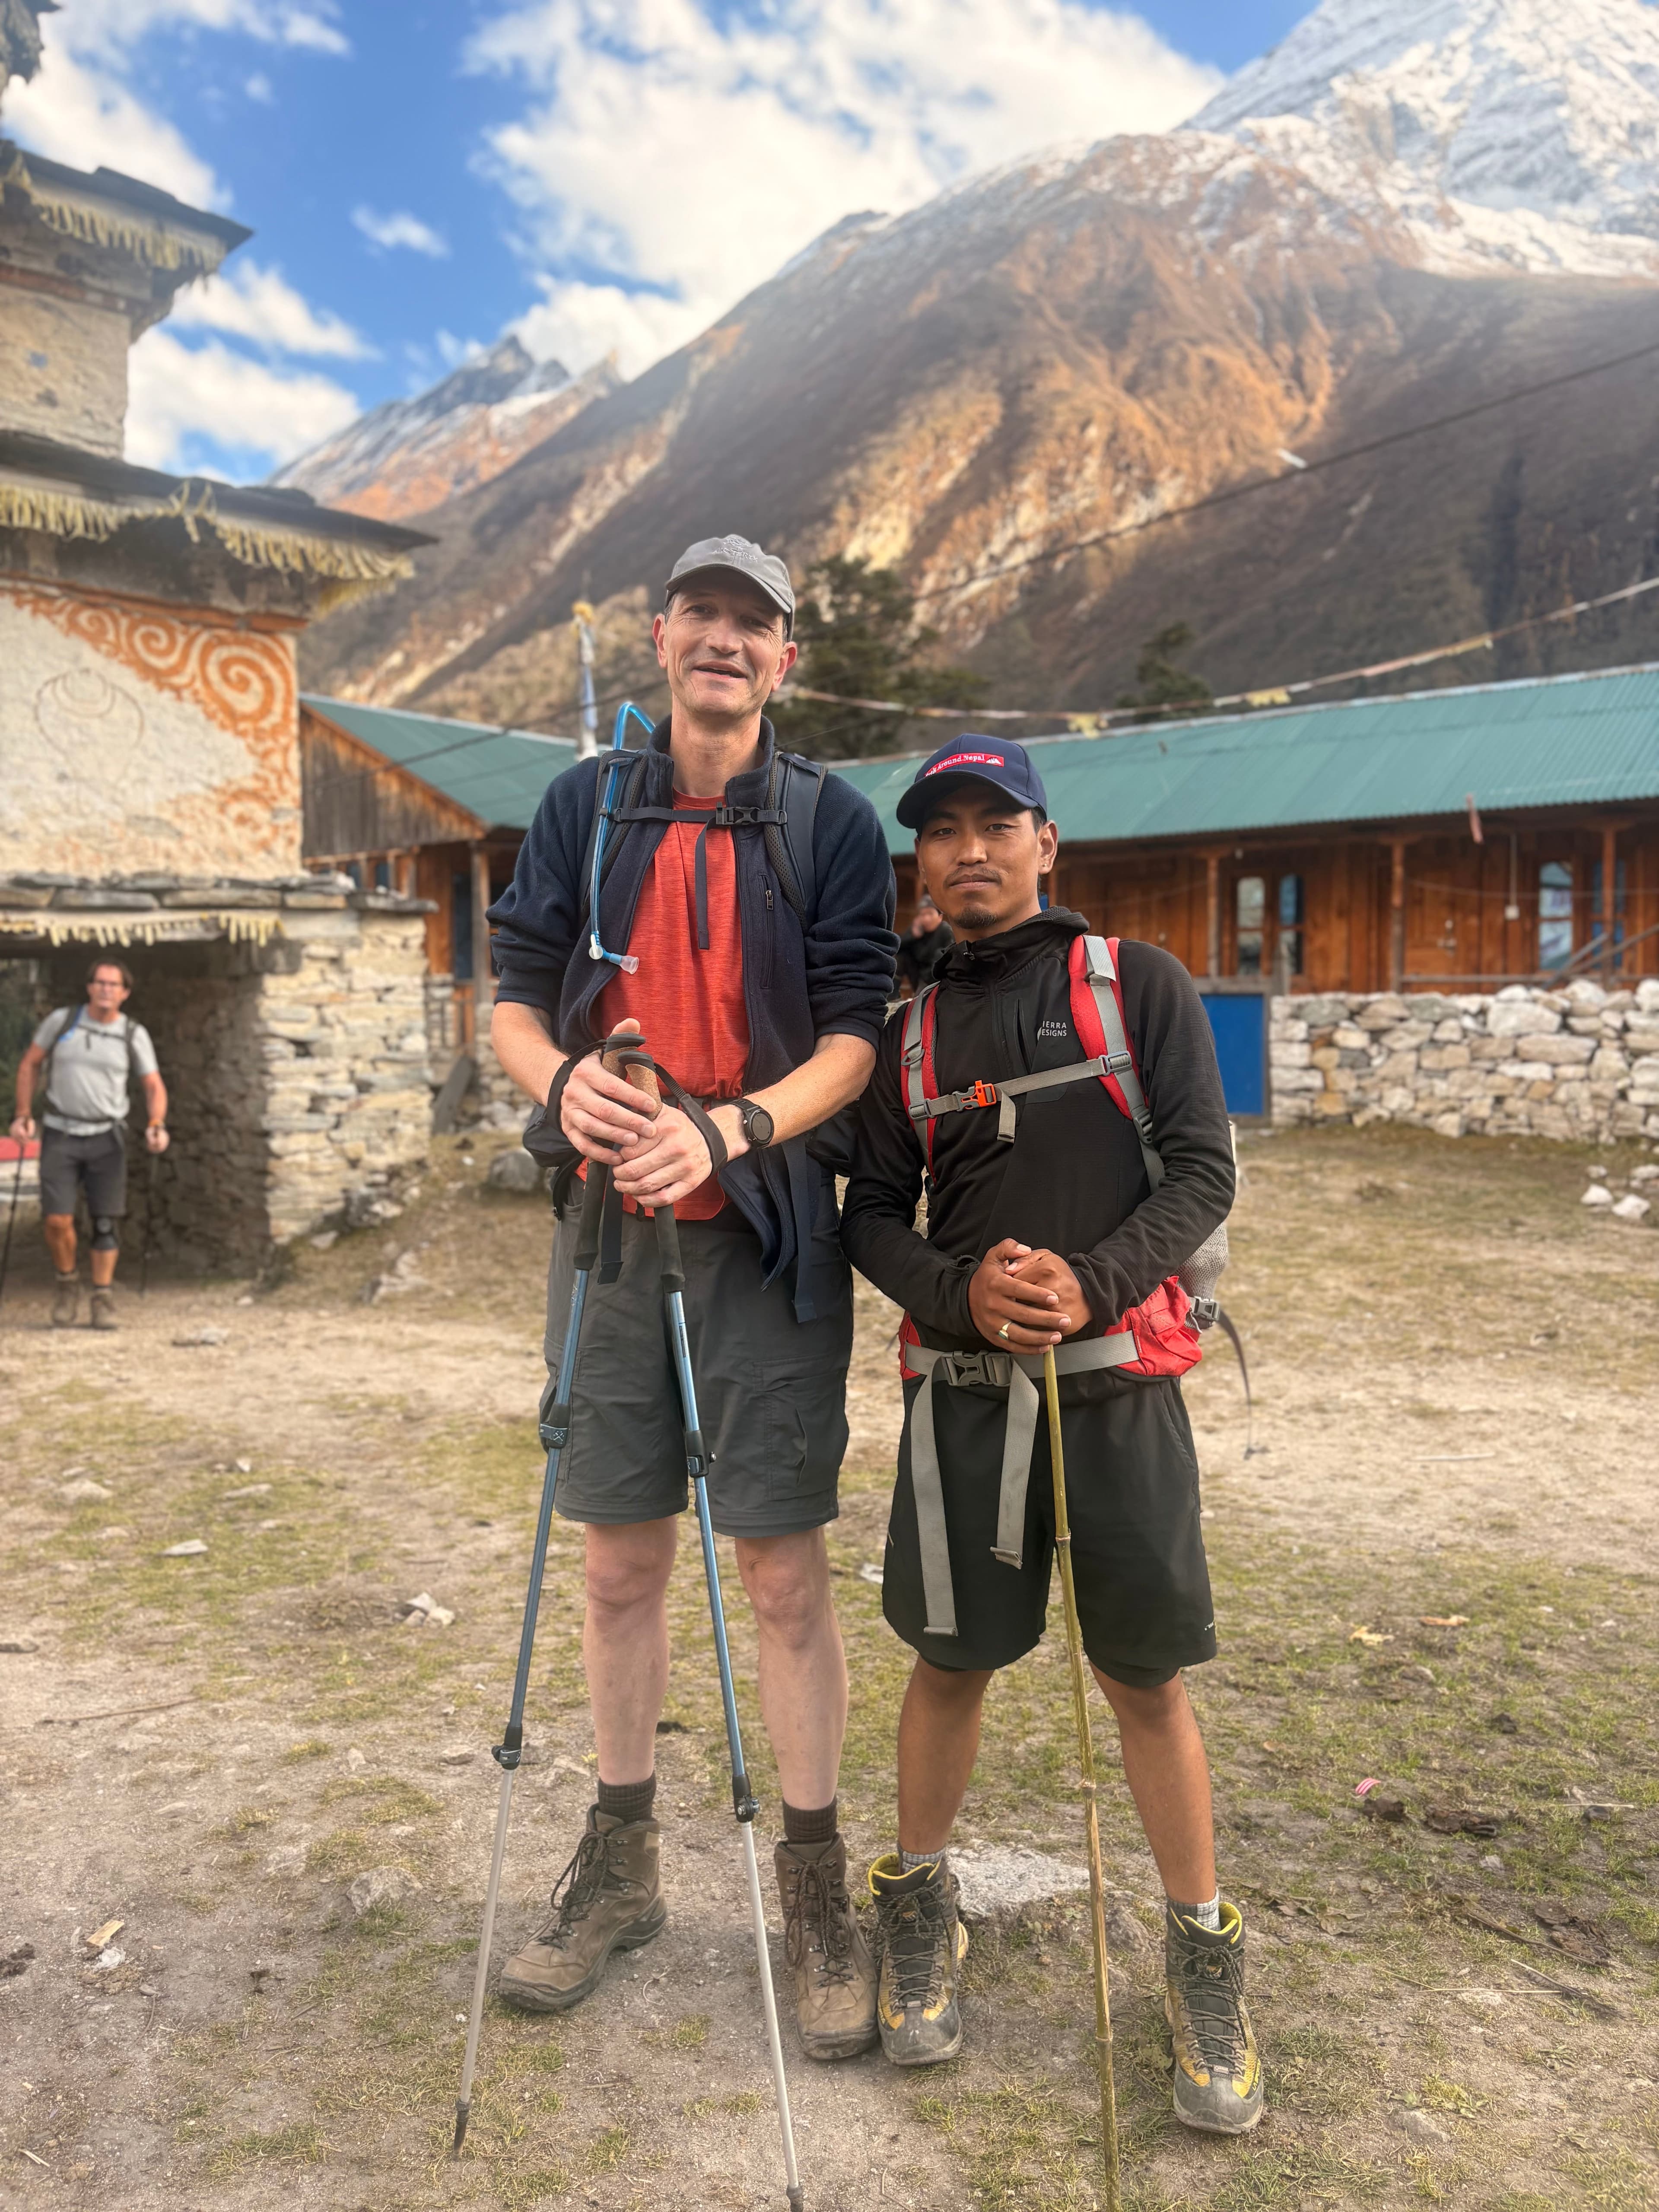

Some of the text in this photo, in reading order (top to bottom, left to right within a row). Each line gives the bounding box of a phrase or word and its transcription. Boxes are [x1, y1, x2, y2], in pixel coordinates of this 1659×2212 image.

[938, 755, 962, 771] Around
[963, 753, 985, 762] Nepal
[1042, 1020, 1067, 1029] IERRA
